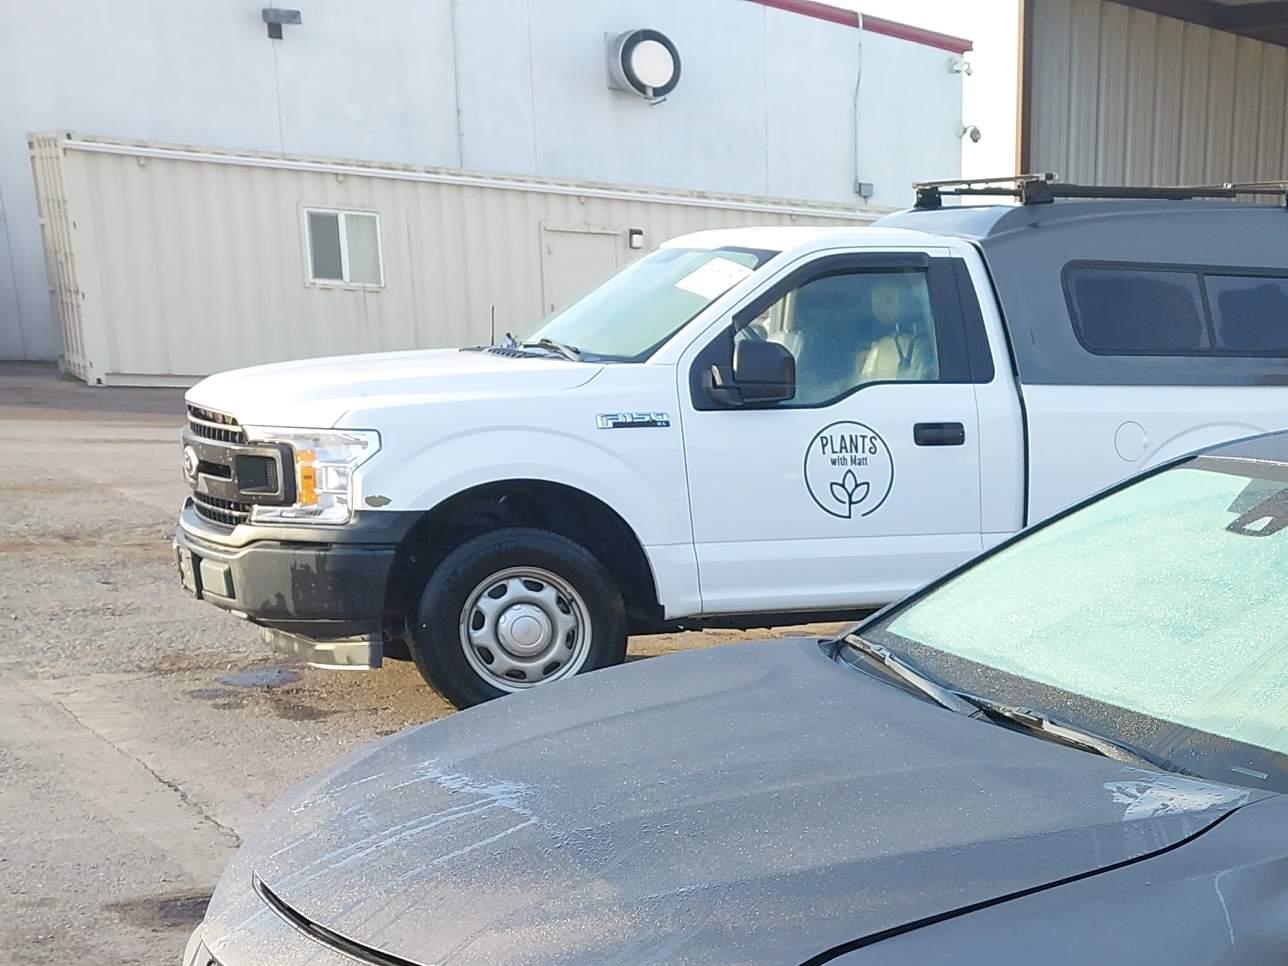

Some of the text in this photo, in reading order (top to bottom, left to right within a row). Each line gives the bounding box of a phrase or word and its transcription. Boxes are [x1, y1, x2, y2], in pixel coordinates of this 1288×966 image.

[820, 434, 877, 456] PLANTS
[831, 454, 868, 466] with Matt
